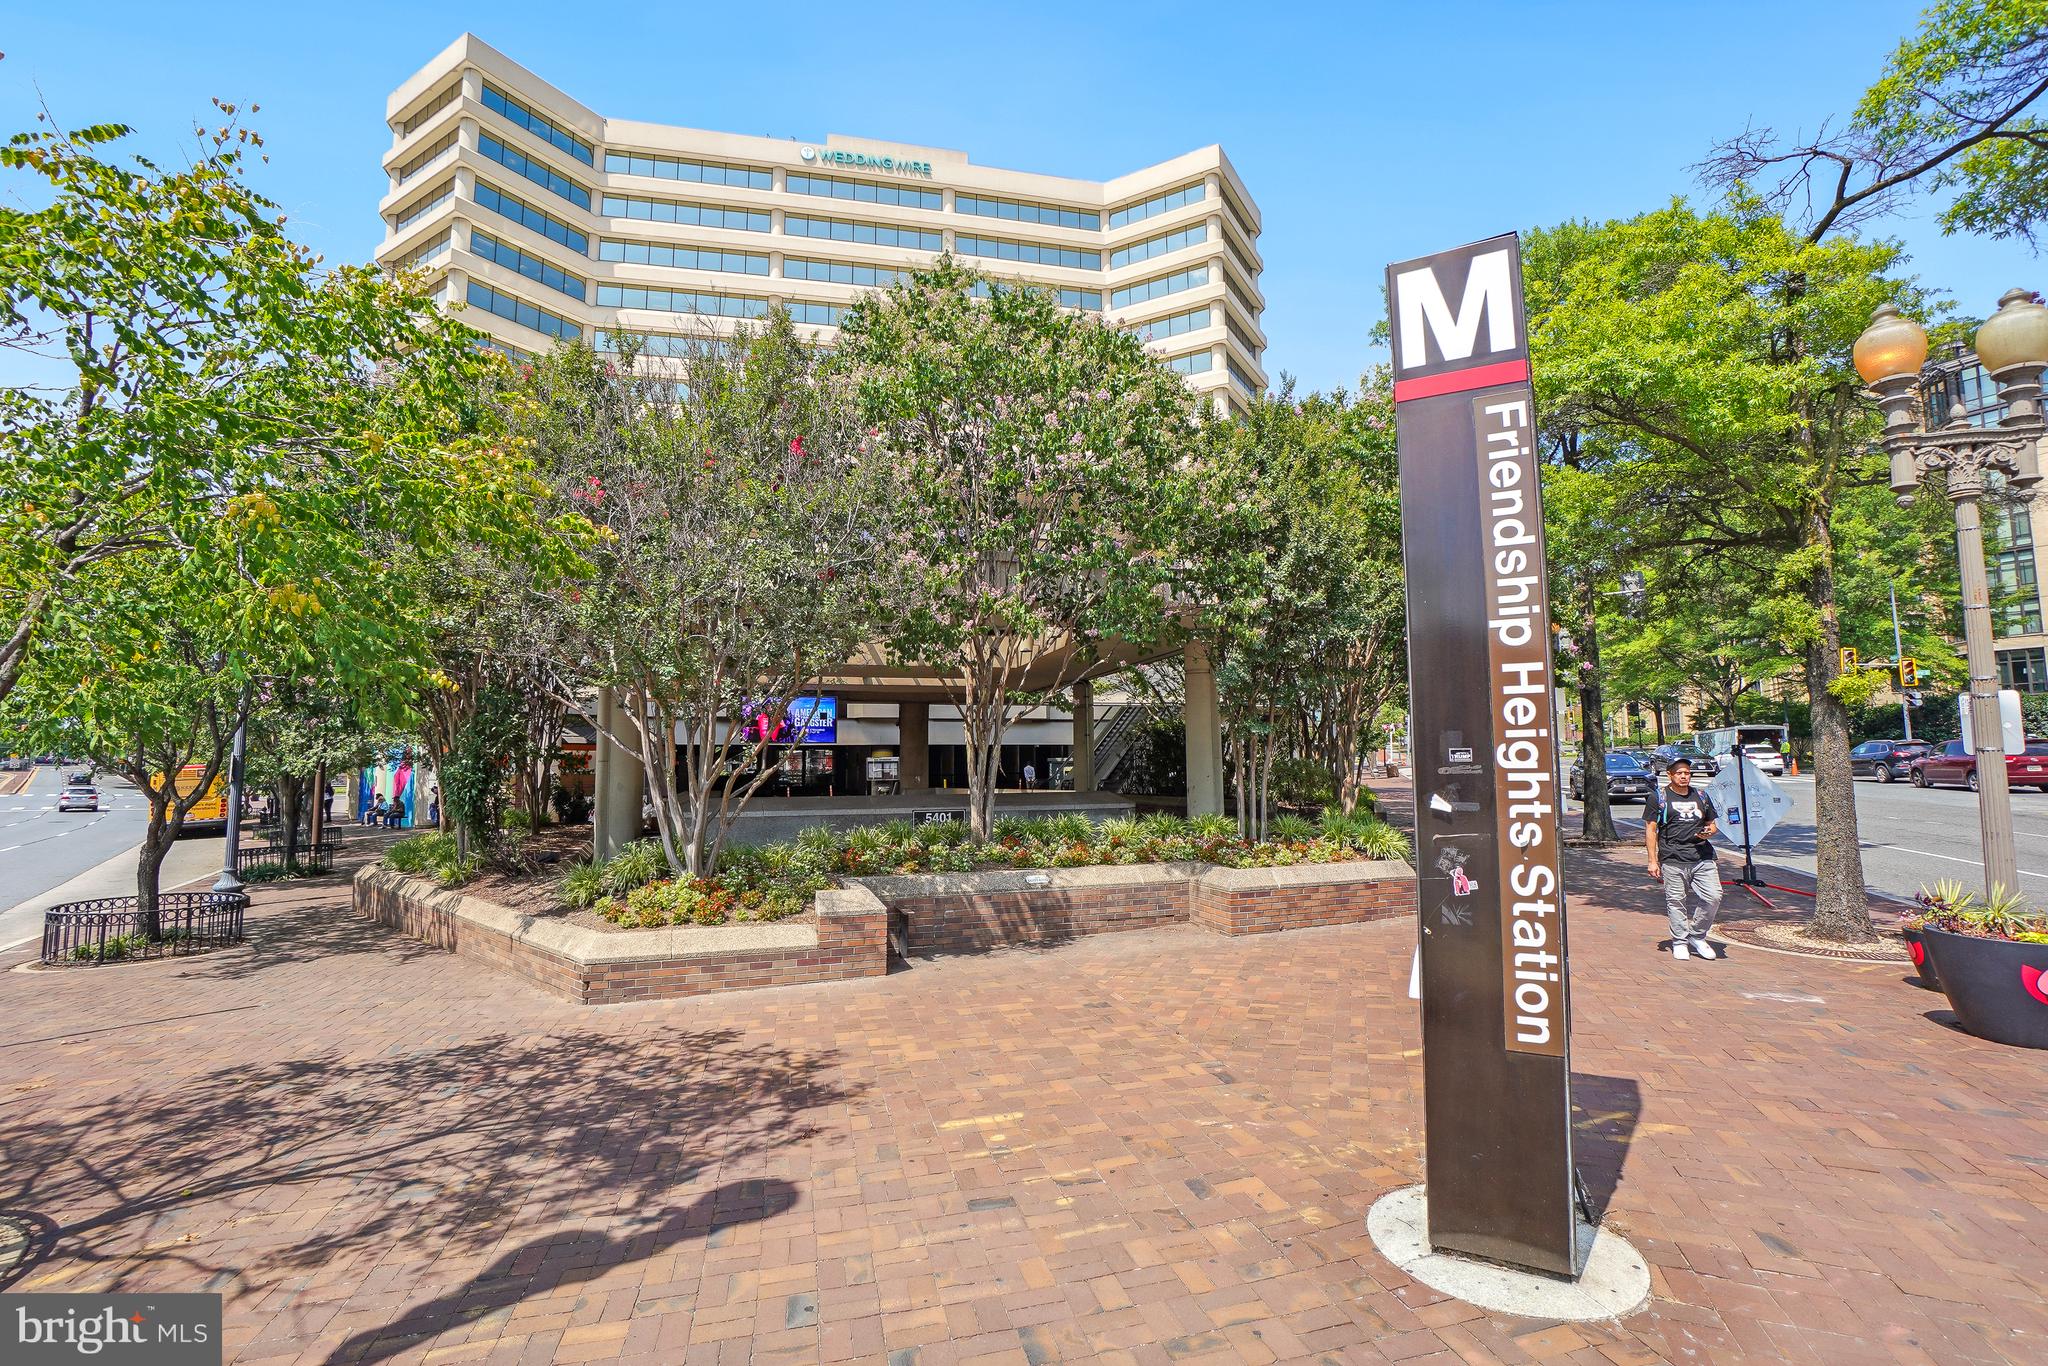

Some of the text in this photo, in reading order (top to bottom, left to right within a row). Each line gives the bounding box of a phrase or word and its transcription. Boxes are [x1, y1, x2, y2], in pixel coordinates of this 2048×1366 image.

[819, 150, 932, 175] WEDDINGWIRE
[1397, 249, 1516, 369] M
[795, 708, 833, 718] AMECN
[795, 717, 833, 727] GAGSTER
[1485, 400, 1558, 1044] Friendship Heights Station
[925, 812, 952, 823] 5401
